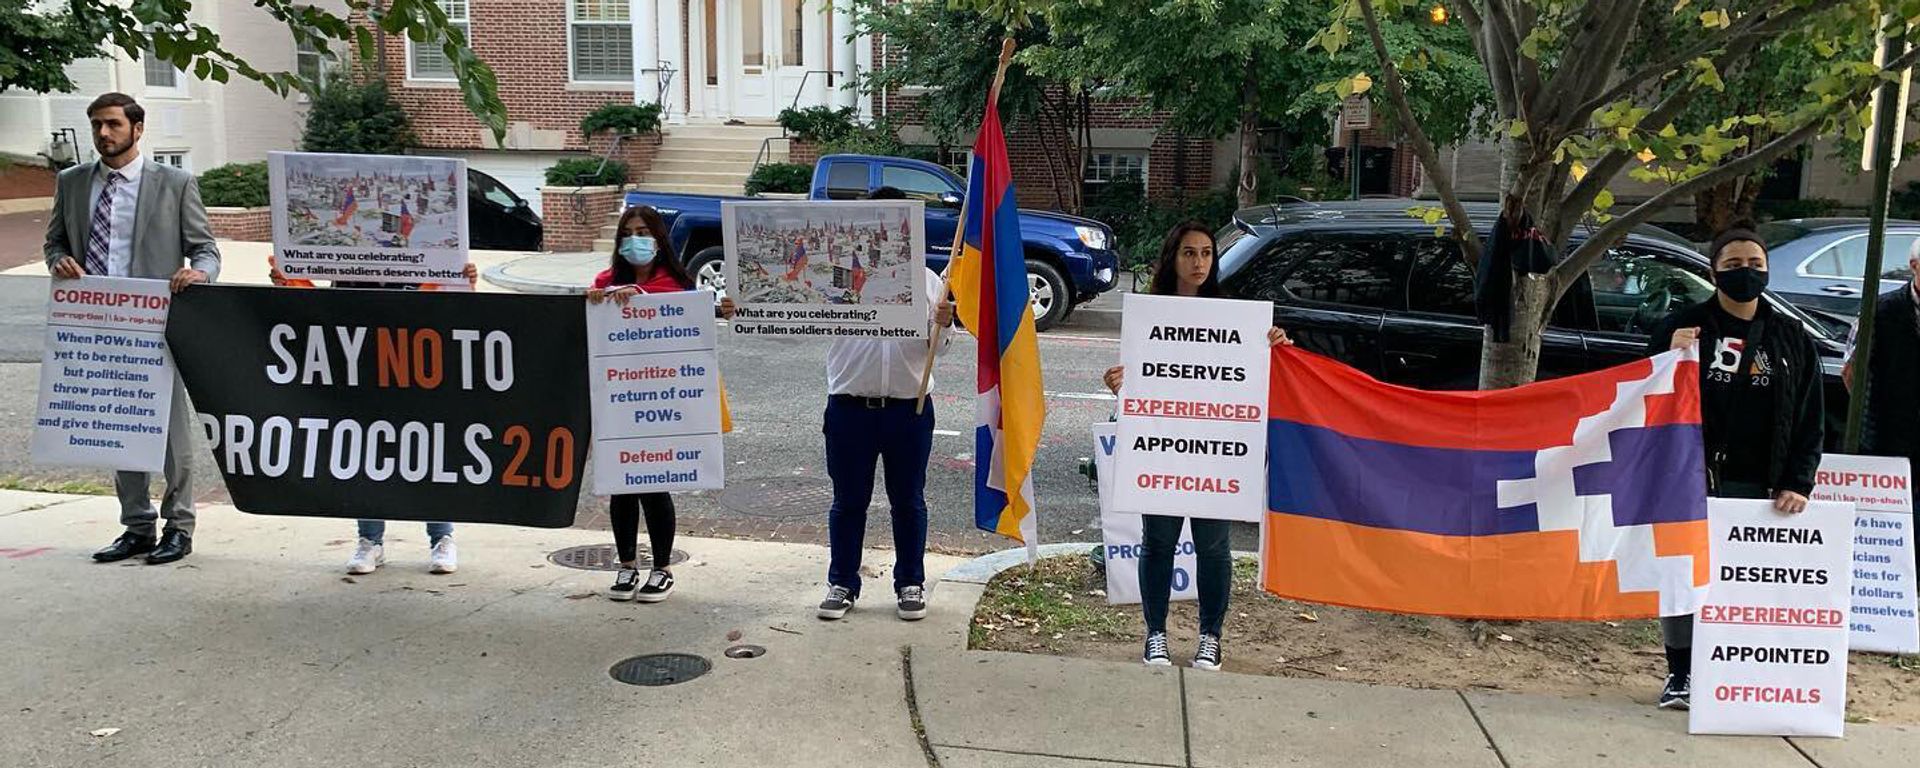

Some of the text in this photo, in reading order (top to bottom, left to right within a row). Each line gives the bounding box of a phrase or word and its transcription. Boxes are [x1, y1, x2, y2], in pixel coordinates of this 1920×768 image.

[283, 250, 425, 263] What are you celebrating?
[284, 265, 305, 274] Our
[307, 265, 337, 275] fallen
[339, 266, 381, 276] soldiers
[383, 268, 427, 277] deserve
[621, 304, 685, 320] Stop the
[735, 308, 877, 322] What are you celebrating?
[608, 325, 701, 342] celebrations
[735, 324, 920, 338] Our fallen soldiers deserve better.
[1149, 325, 1242, 345] ARMENIA
[57, 331, 165, 349] When POWs have
[54, 350, 163, 366] yet to be returned
[266, 323, 514, 392] SAY NO TO
[64, 366, 149, 382] but politicians
[606, 364, 706, 382] Prioritize the
[1141, 362, 1246, 382] DESERVES
[53, 383, 156, 400] throw parties for
[610, 387, 704, 403] return of our
[49, 400, 155, 417] millions of dollars
[634, 409, 682, 423] POWs
[1123, 398, 1261, 420] EXPERIENCED
[38, 416, 163, 434] and give themselves
[69, 434, 125, 449] bonuses.
[1133, 436, 1248, 457] APPOINTED
[197, 412, 575, 490] PROTOCOLS 2.0
[619, 449, 702, 464] Defend our
[625, 470, 698, 486] homeland
[1137, 473, 1240, 494] OFFICIALS
[1816, 471, 1907, 489] RUPTION
[1870, 517, 1902, 530] have
[1728, 526, 1824, 545] ARMENIA
[1853, 551, 1891, 564] icians
[1720, 566, 1828, 585] DESERVES
[1853, 569, 1901, 581] ties for
[1858, 586, 1904, 600] dollars
[1701, 605, 1843, 627] EXPERIENCED
[1851, 604, 1914, 618] emselves
[1711, 646, 1830, 664] APPOINTED
[1715, 686, 1821, 704] OFFICIALS
